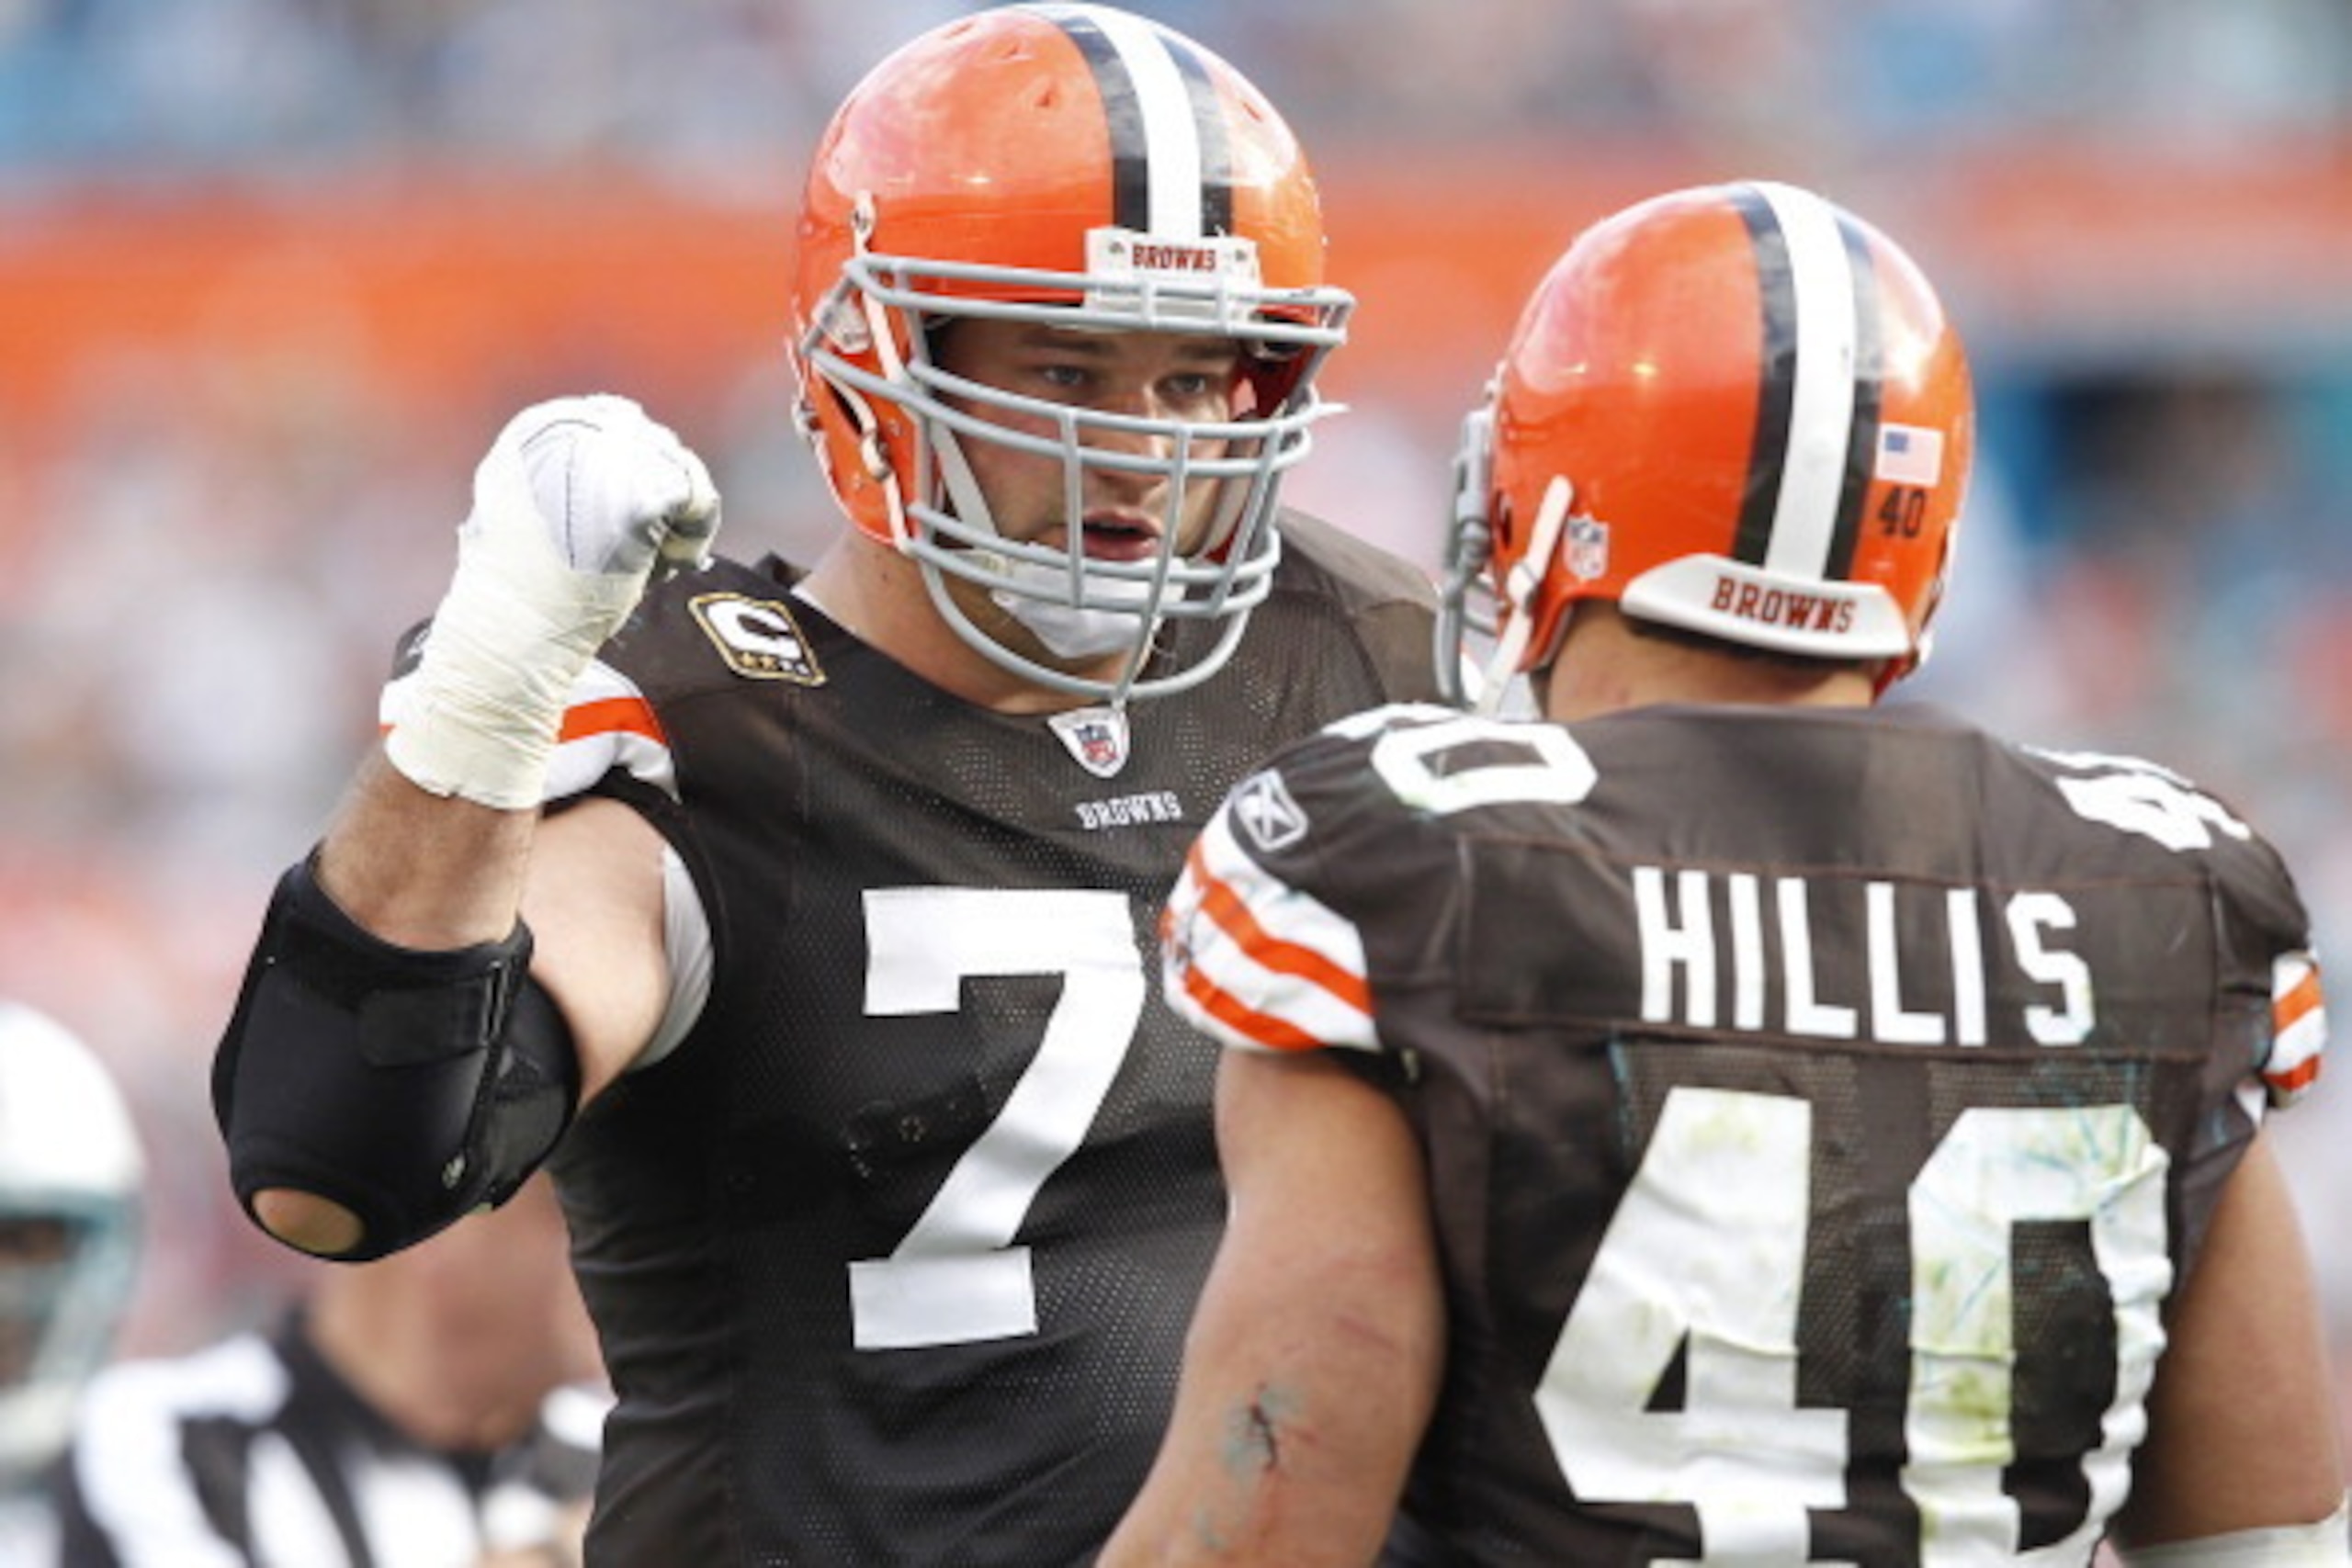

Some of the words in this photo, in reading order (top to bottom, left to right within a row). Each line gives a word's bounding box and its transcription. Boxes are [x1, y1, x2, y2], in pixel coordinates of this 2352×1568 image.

[1131, 243, 1216, 271] BROWNS
[1878, 485, 1927, 538] 40
[707, 601, 802, 660] C
[1711, 576, 1856, 634] BROWNS
[1076, 791, 1182, 830] BROWNS
[1633, 865, 2096, 1047] HILLIS
[848, 886, 1146, 1350] 7
[1533, 1086, 2173, 1568] 40
